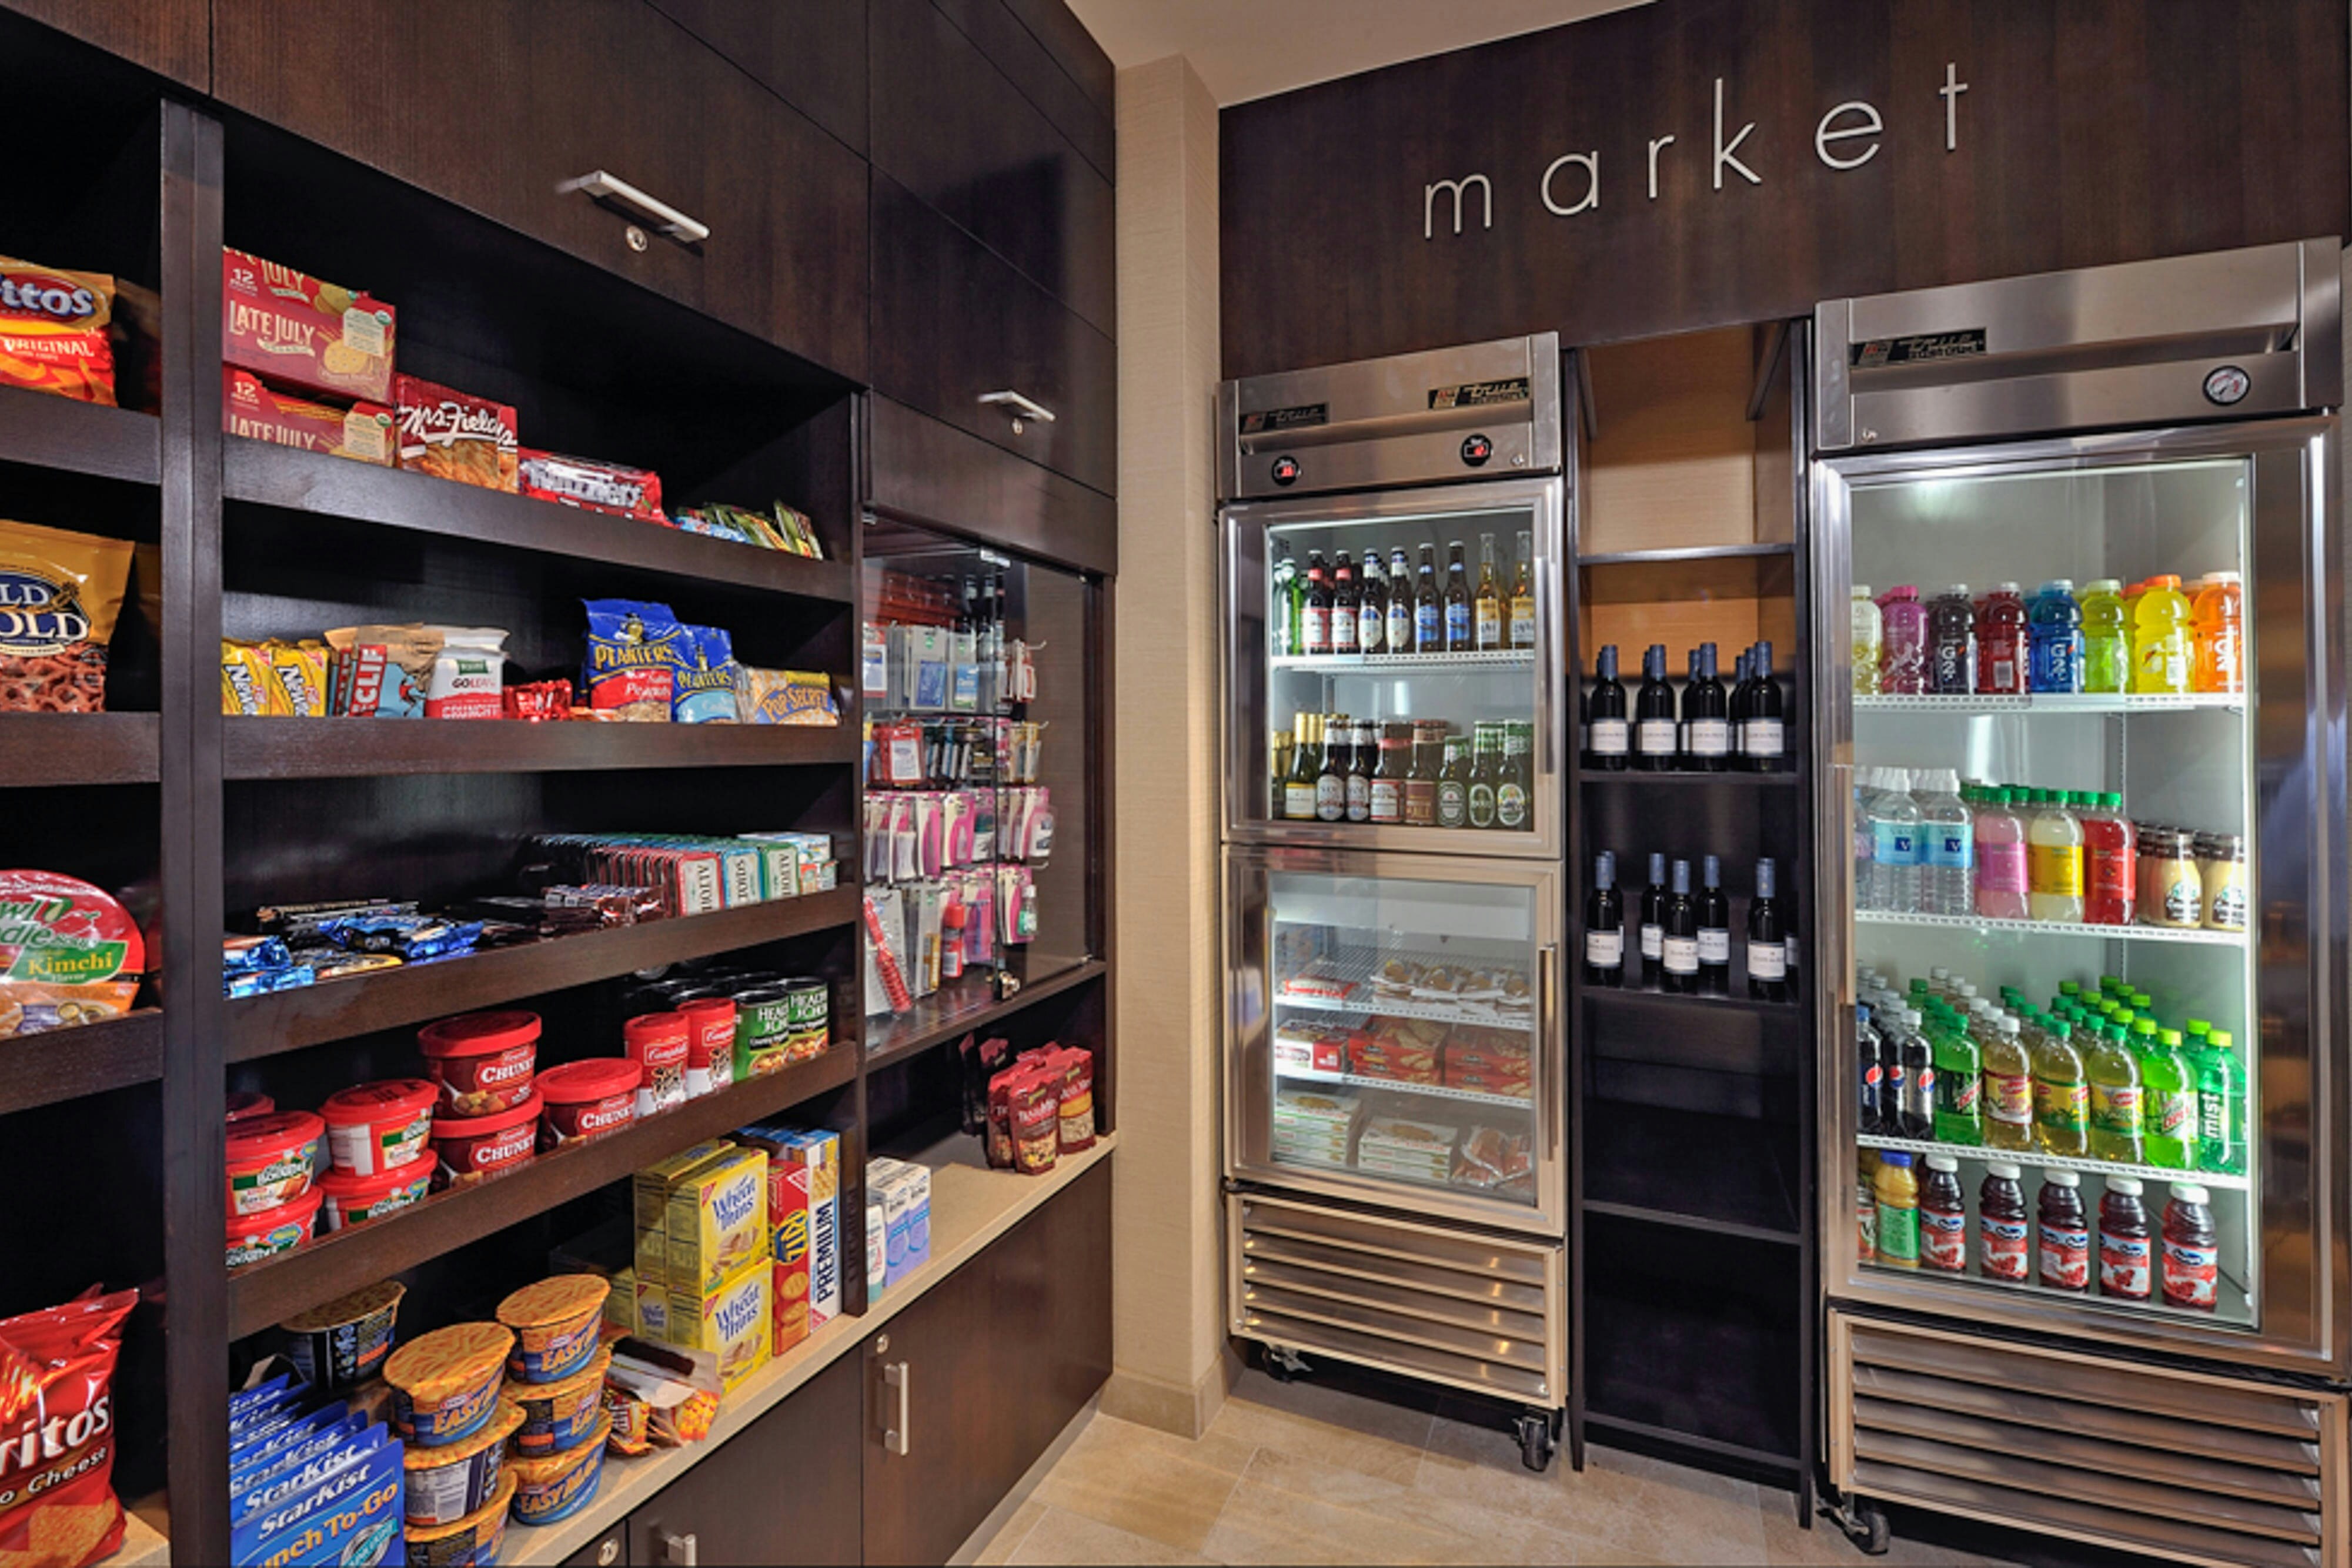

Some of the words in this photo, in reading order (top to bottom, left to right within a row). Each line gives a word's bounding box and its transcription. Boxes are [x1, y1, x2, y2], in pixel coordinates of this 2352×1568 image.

[1425, 62, 1968, 239] market
[233, 268, 253, 283] 12
[229, 300, 272, 336] LATE
[270, 314, 316, 346] JULY
[235, 381, 255, 396] 12
[0, 583, 49, 606] LD
[0, 610, 89, 643] OLD
[355, 648, 385, 704] CLIF
[28, 951, 113, 975] Kimchi
[780, 1209, 809, 1263] RITZ
[816, 1201, 834, 1305] PREMIUM
[0, 1394, 111, 1477] ritos
[28, 1446, 108, 1495] Cheese
[243, 1444, 357, 1515] StarKist
[258, 1464, 371, 1540] StarKist
[324, 1483, 398, 1538] To-Go
